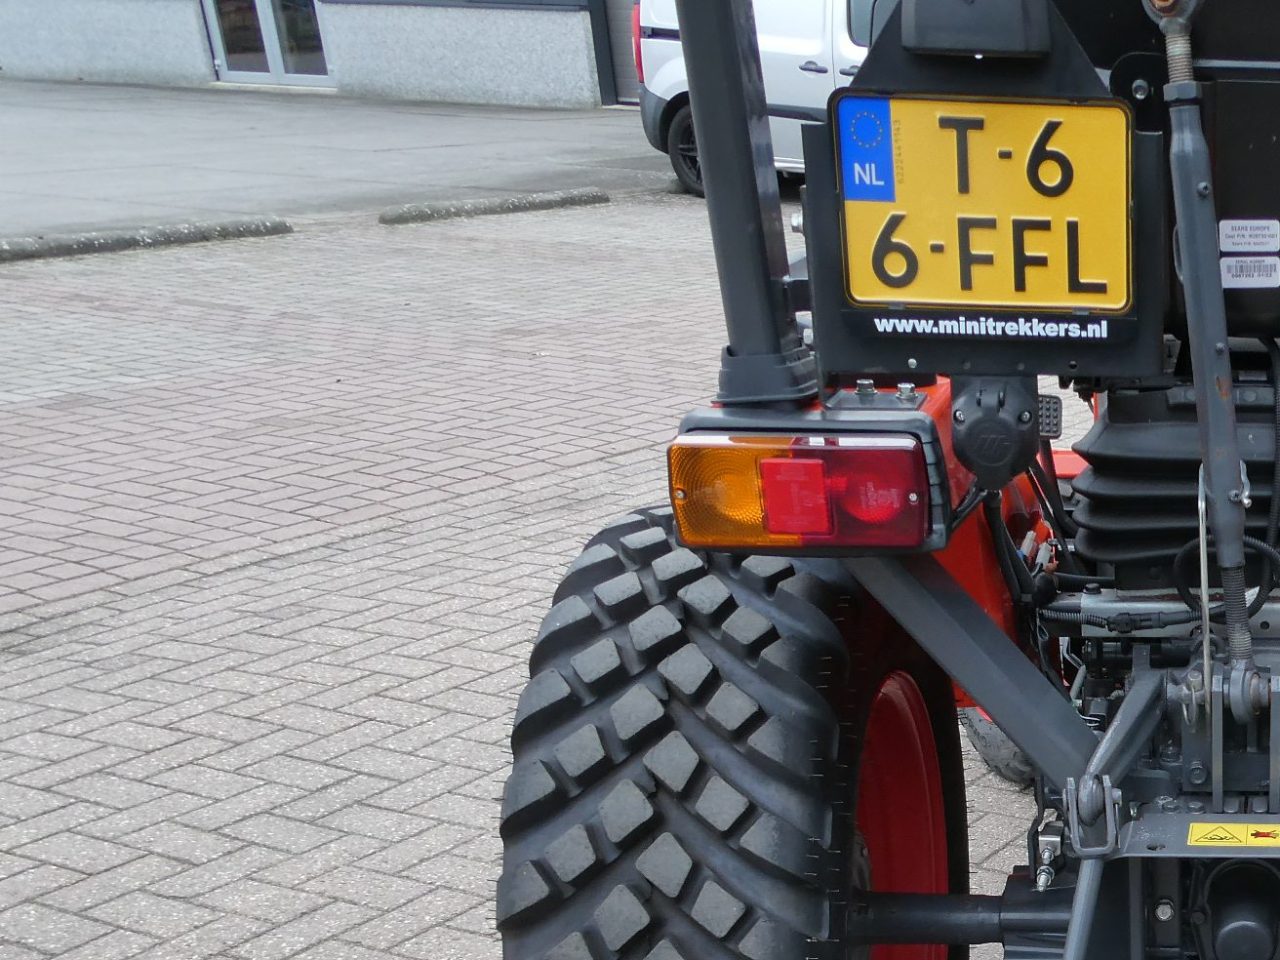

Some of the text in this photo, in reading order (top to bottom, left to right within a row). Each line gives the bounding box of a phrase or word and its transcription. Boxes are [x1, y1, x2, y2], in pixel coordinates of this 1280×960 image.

[853, 162, 885, 186] NL
[937, 115, 1074, 198] T-6
[871, 213, 1108, 294] 6-FFL
[874, 316, 1108, 338] www.minitrekkers.nl
